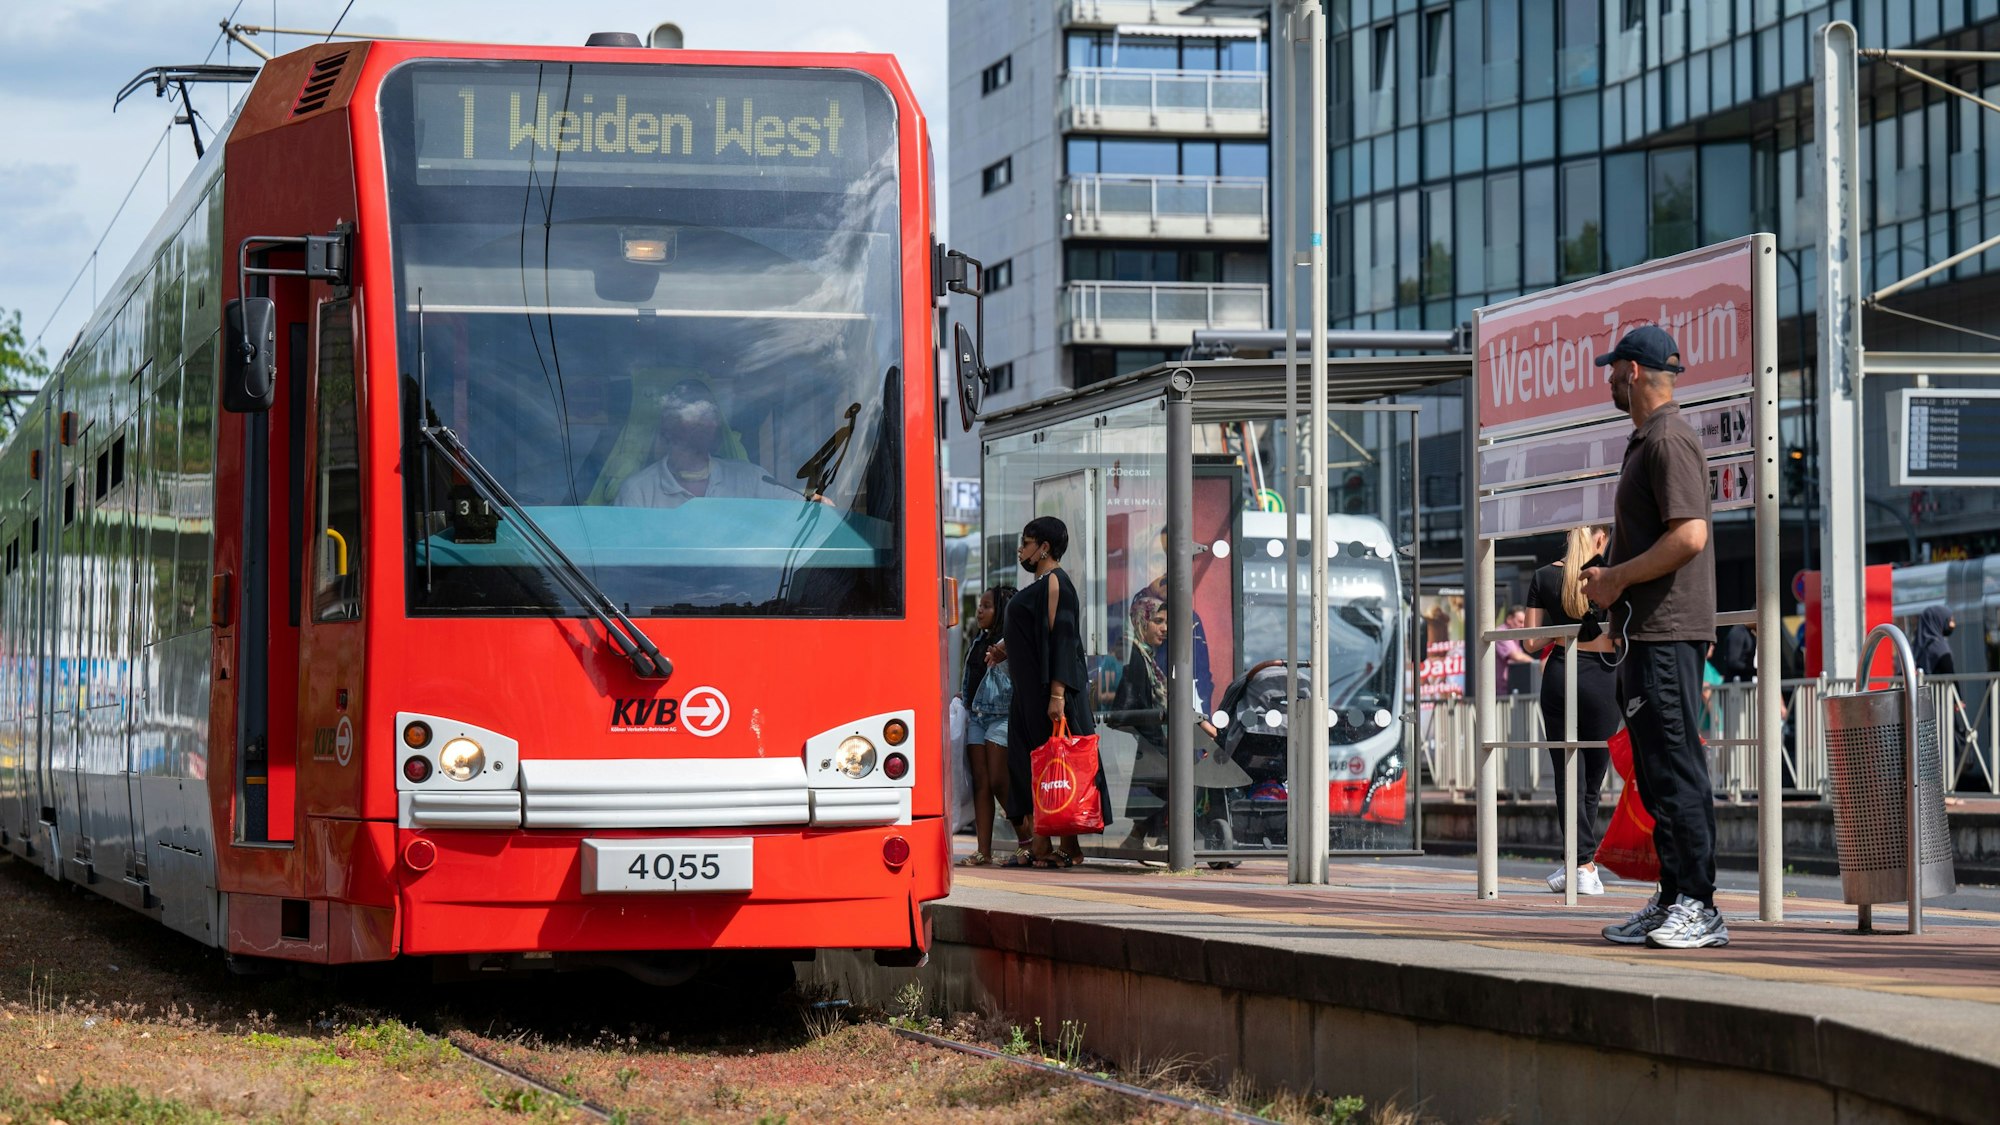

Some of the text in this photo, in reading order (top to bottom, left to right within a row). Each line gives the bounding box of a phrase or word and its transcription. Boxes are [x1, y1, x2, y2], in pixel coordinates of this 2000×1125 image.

[458, 87, 845, 158] 1 Weiden West
[1488, 321, 1594, 408] Weiden
[1706, 424, 1719, 435] West
[1723, 418, 1729, 437] 1
[1106, 467, 1151, 476] JCDecaux
[460, 500, 470, 516] 3
[1124, 498, 1162, 506] EINMAL
[611, 698, 678, 726] KVB
[314, 727, 336, 755] KVB
[628, 853, 720, 880] 4055
[672, 878, 677, 891] 1
